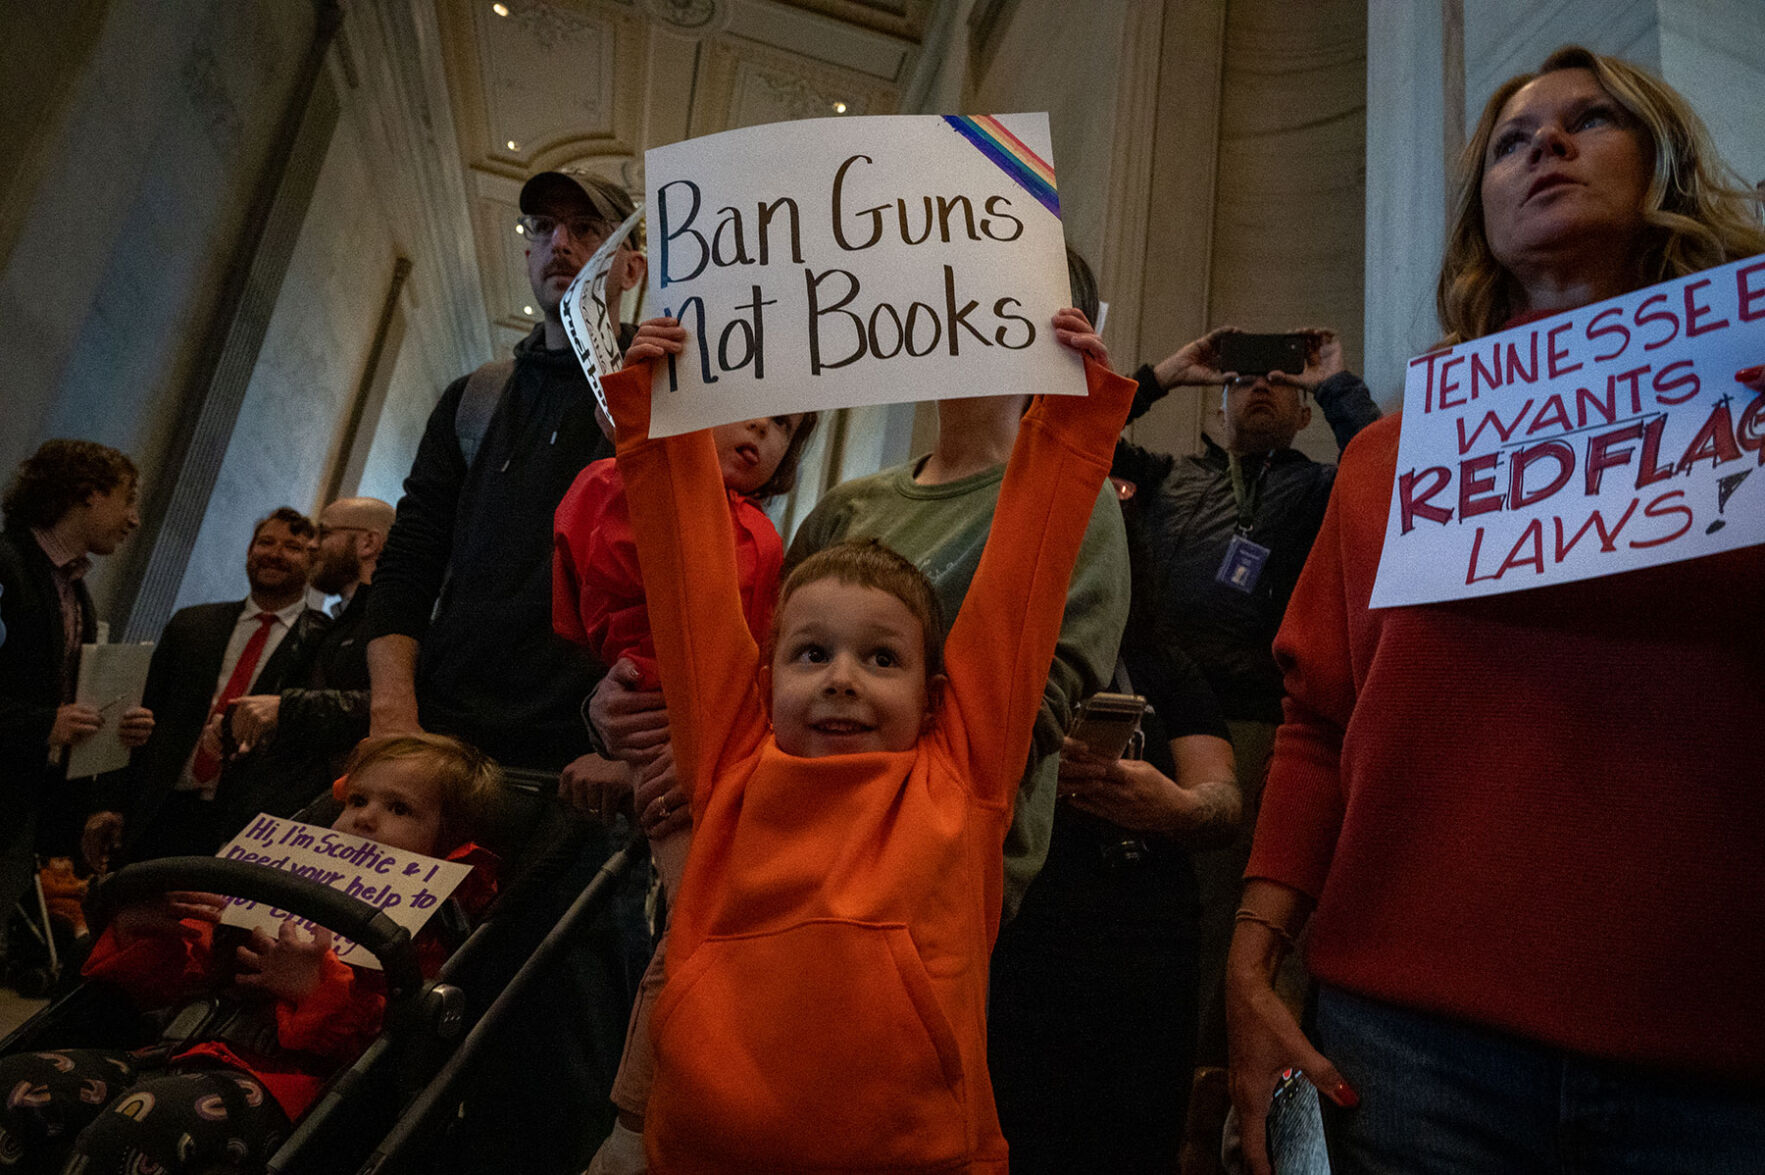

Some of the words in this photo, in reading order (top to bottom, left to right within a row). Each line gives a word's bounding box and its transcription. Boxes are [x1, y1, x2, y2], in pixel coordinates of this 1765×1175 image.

[658, 180, 805, 289] Ban
[832, 154, 1025, 251] Guns
[805, 264, 1036, 376] Books
[1409, 261, 1765, 415] TENNESSEE
[1456, 359, 1701, 455] WANTS
[1465, 469, 1754, 586] LAWS!
[245, 816, 280, 848] Hi,
[278, 825, 315, 849] I'm
[313, 833, 396, 874] Scottie
[423, 864, 440, 883] I
[345, 876, 402, 912] help
[409, 888, 438, 909] to
